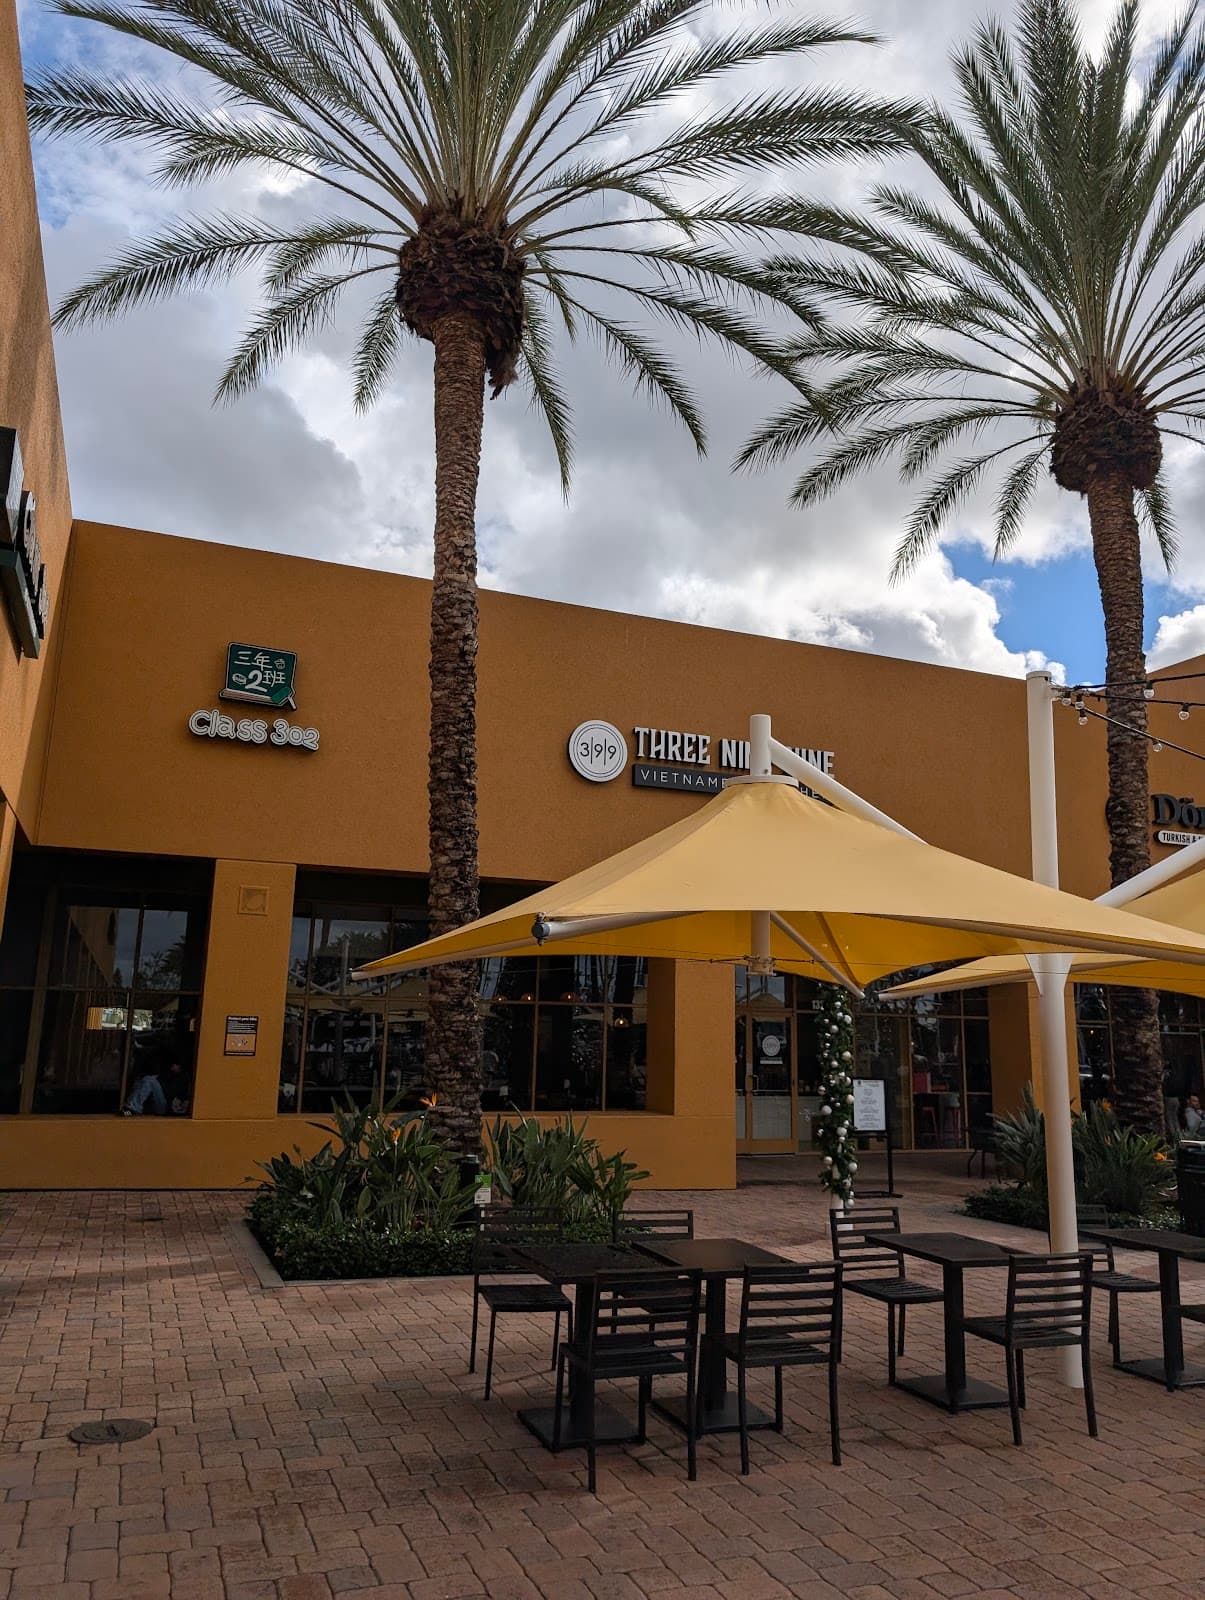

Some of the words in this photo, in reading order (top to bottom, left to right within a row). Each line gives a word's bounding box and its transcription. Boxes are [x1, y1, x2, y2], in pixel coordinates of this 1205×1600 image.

[233, 650, 273, 671] 三年
[189, 709, 268, 743] Class
[270, 718, 320, 750] 302
[634, 726, 711, 765] THREE
[721, 738, 750, 770] NI
[640, 769, 728, 789] VIETNAME
[1162, 832, 1191, 844] TURKISH
